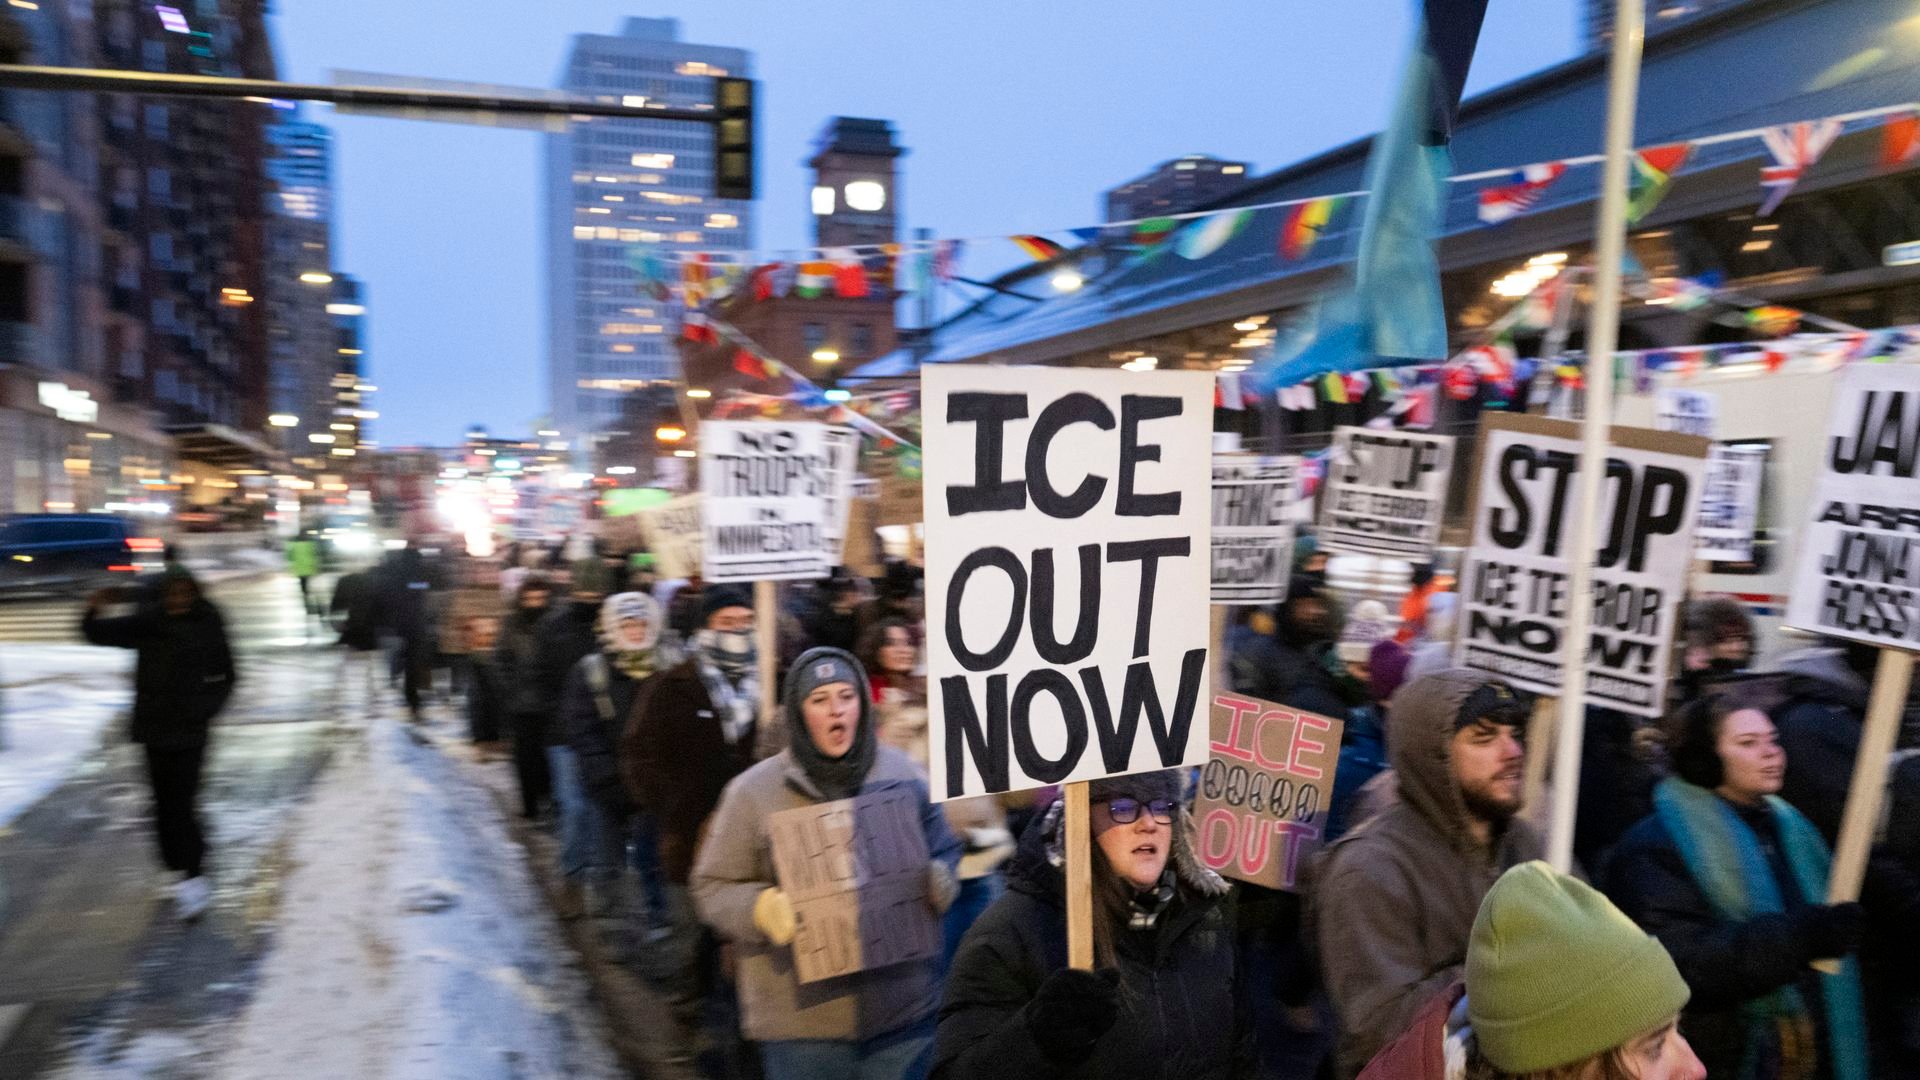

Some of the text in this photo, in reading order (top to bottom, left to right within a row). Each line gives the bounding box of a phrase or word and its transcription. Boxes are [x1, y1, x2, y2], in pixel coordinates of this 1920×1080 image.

[946, 392, 1183, 519] ICE
[945, 536, 1190, 671] OUT
[1474, 559, 1661, 637] ICE TEROR
[940, 648, 1207, 798] NOW
[1209, 696, 1331, 779] ICE
[1200, 808, 1319, 888] OUT
